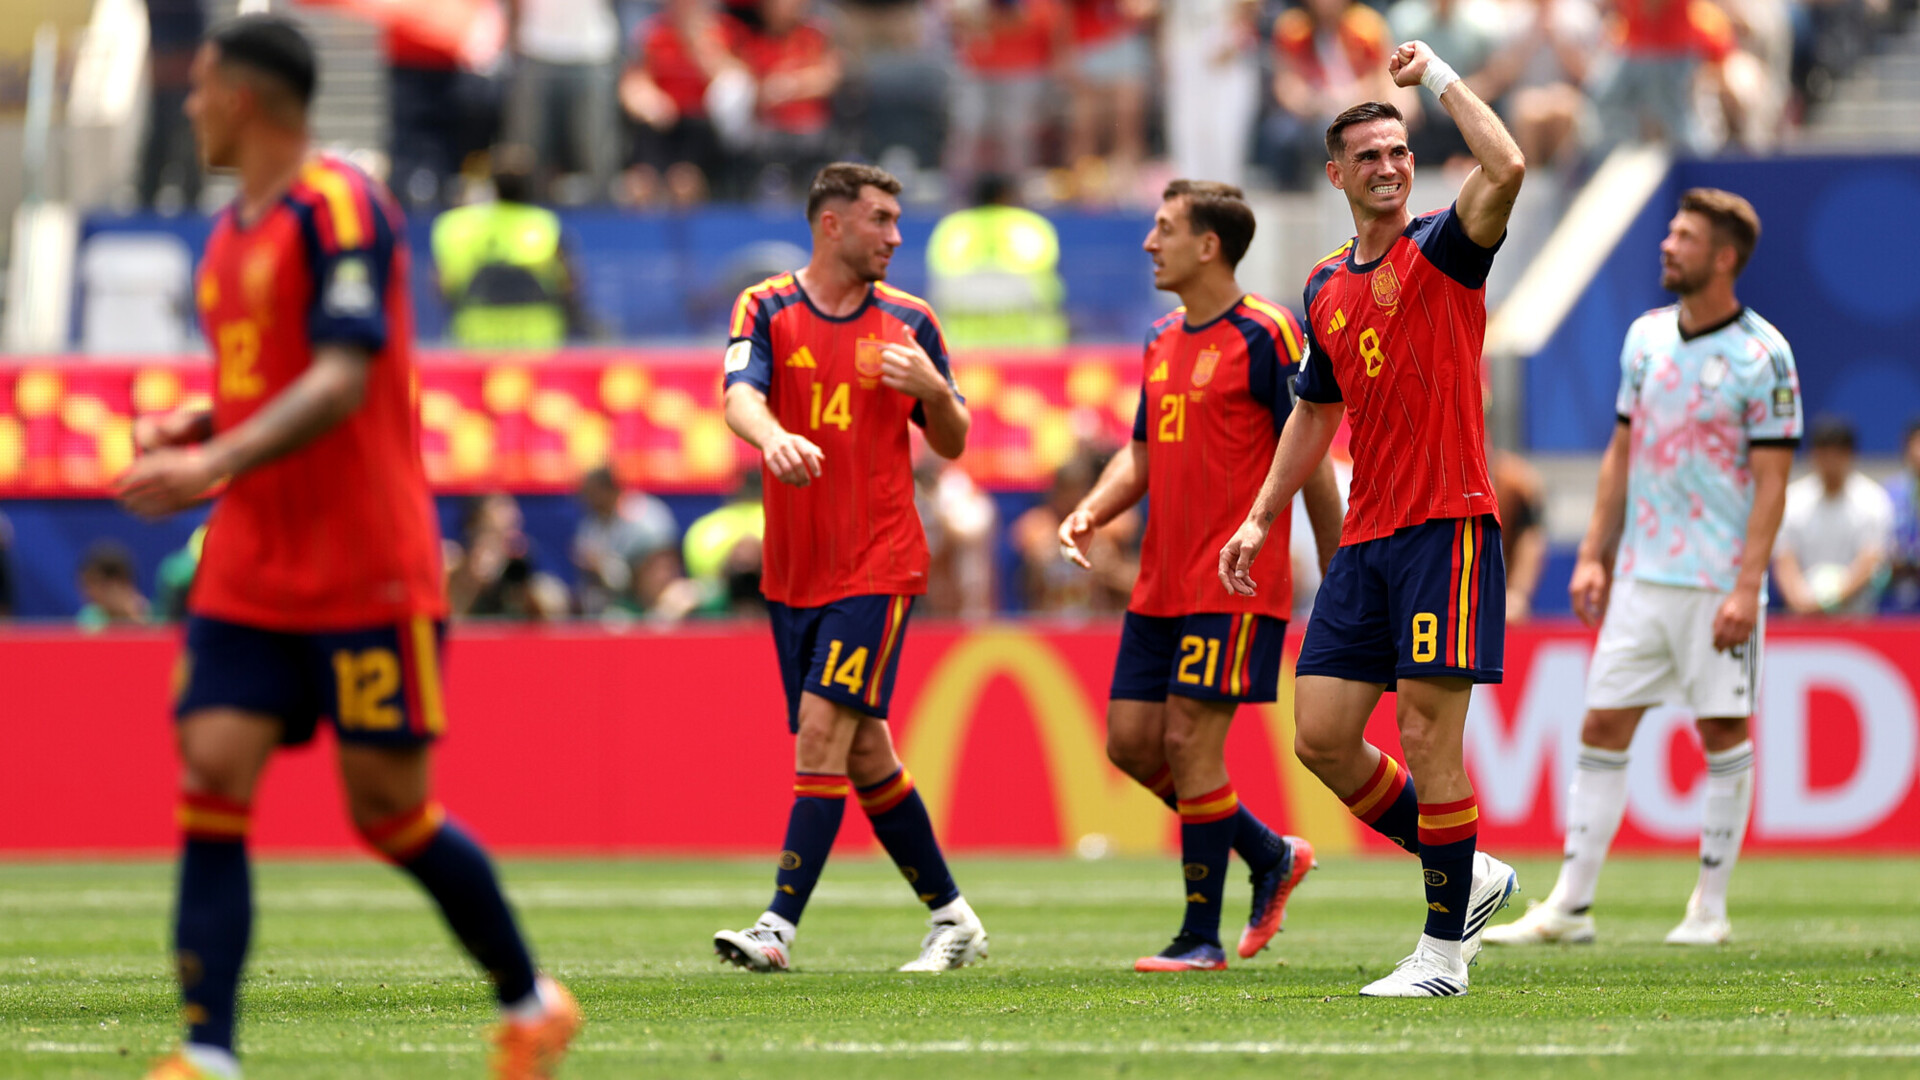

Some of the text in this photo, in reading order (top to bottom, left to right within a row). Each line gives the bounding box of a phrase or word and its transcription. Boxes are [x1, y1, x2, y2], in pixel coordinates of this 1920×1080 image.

[219, 320, 265, 400] 12
[1359, 327, 1385, 377] 8
[810, 382, 852, 431] 14
[1158, 394, 1186, 442] 21
[1177, 634, 1221, 687] 21
[1412, 612, 1438, 663] 8
[331, 647, 402, 731] 12
[820, 639, 869, 695] 14
[1462, 638, 1917, 842] McD
